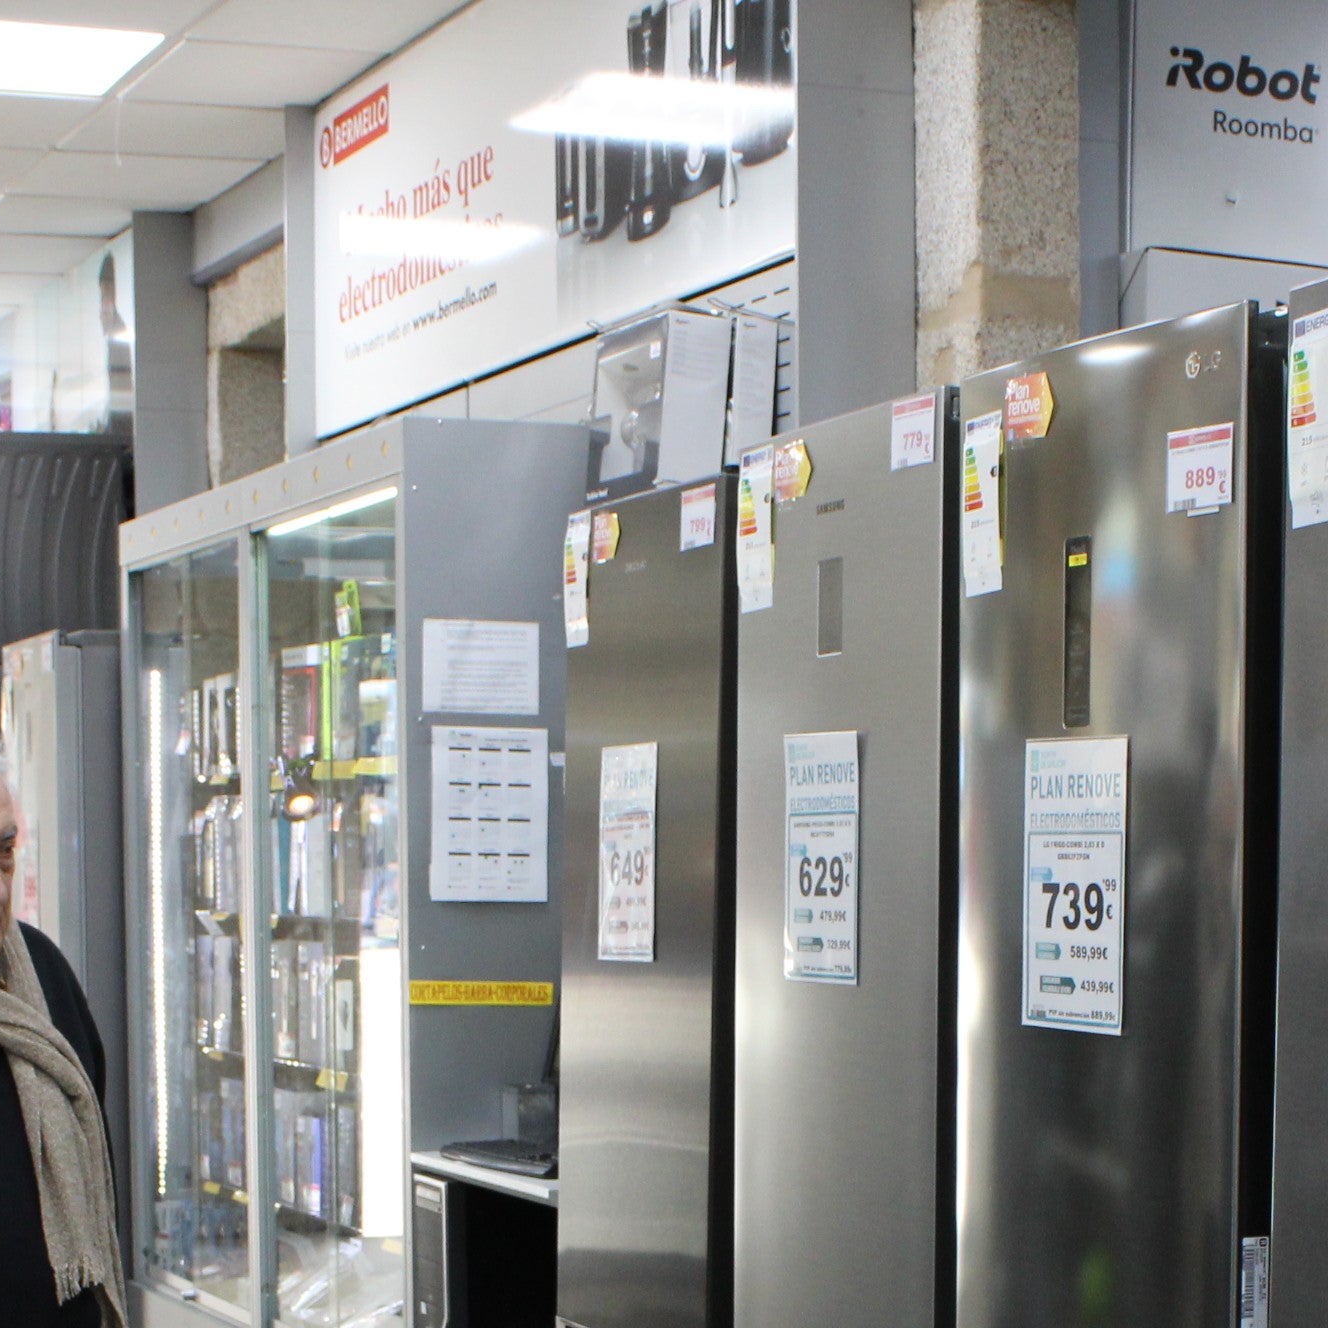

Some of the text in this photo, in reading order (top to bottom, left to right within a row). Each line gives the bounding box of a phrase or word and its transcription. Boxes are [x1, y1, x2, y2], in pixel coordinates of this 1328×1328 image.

[1166, 46, 1321, 105] iRobot
[335, 95, 388, 153] BERMELLO
[1213, 109, 1314, 143] Roomba
[457, 145, 494, 208] que
[1008, 399, 1040, 416] renove
[1185, 466, 1215, 489] 889
[790, 762, 855, 786] PLAN RENOVE
[1031, 773, 1121, 799] PLAN RENOVE
[1030, 809, 1121, 829] ELECTRODOMÉSTICOS
[610, 850, 644, 887] 649
[799, 856, 843, 897] 629
[1042, 882, 1104, 931] 739
[1106, 905, 1113, 919] €
[1070, 946, 1108, 962] 589,99€
[1080, 980, 1114, 995] 439,99€
